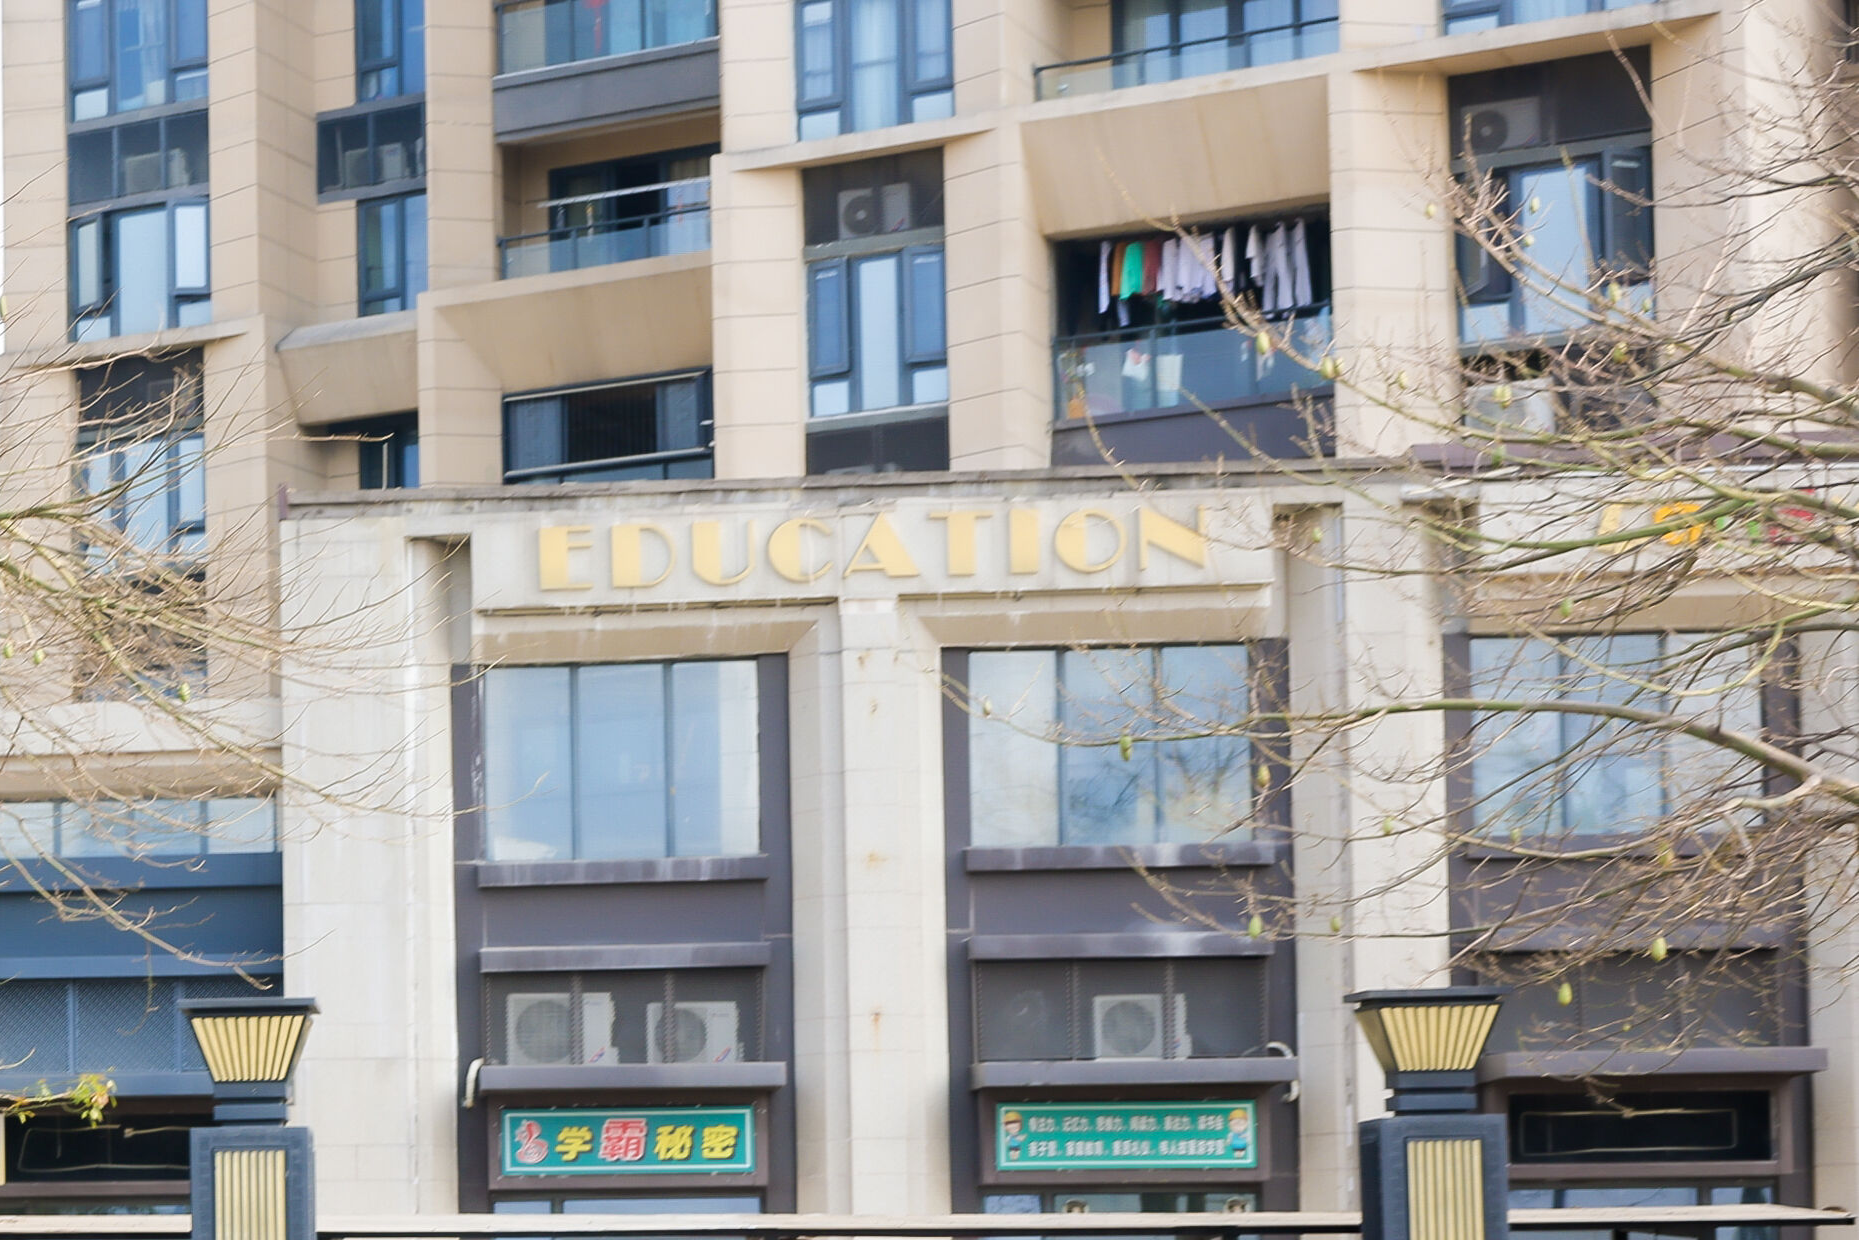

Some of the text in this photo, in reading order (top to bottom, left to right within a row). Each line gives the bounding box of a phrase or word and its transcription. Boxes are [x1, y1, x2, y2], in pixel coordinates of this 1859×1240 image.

[539, 503, 1206, 592] EDUCATION
[554, 1117, 740, 1162] 学霸秘密
